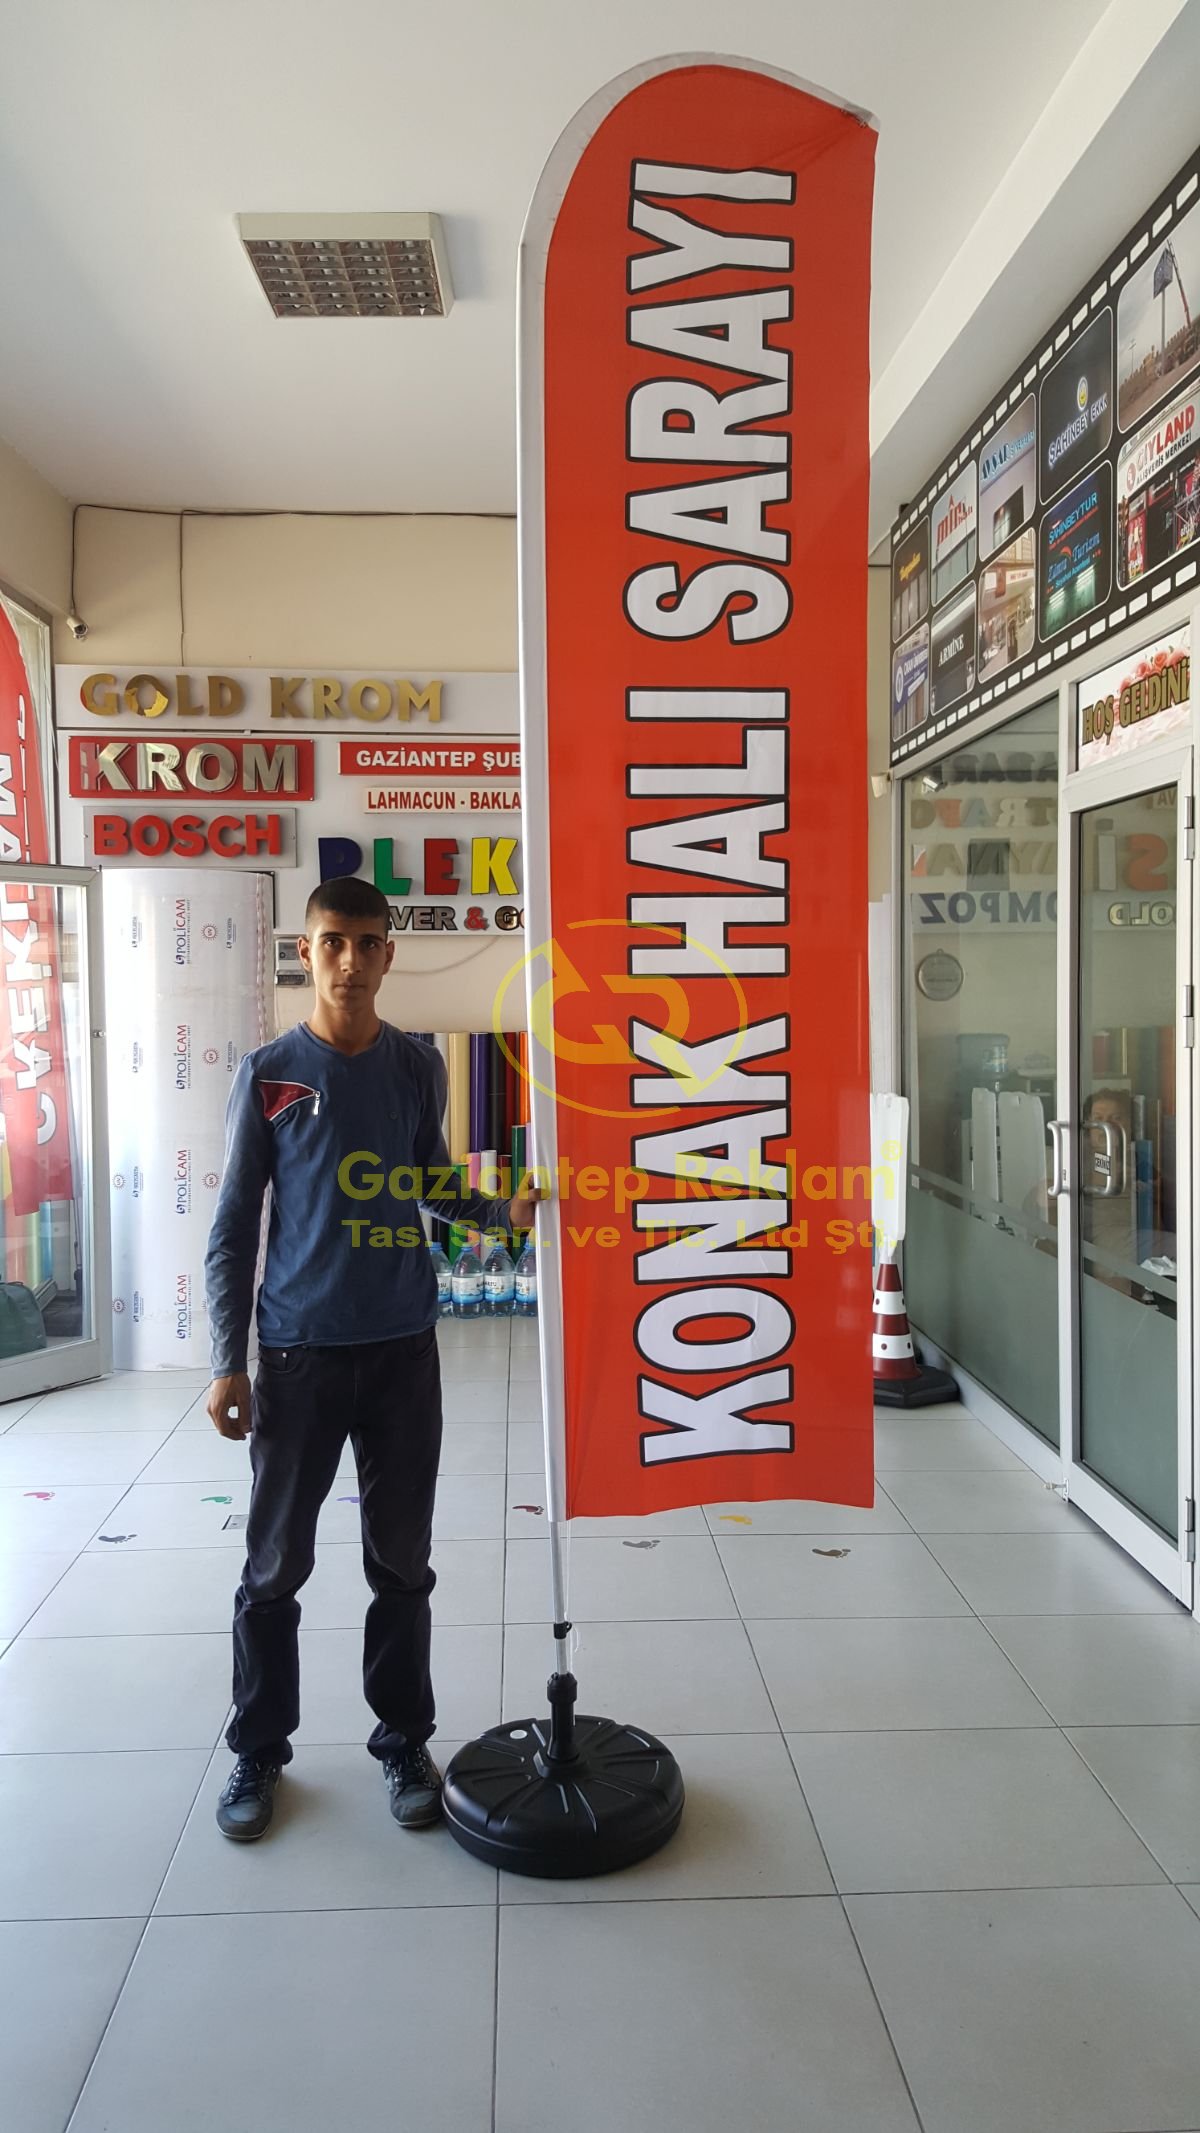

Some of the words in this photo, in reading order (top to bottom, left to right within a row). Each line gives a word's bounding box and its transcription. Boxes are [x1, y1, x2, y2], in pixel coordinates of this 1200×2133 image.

[622, 157, 797, 645] SARAYI
[80, 672, 246, 718] GOLD
[270, 677, 445, 722] KROM
[1081, 693, 1115, 746] HOŞ
[79, 742, 299, 793] KROM
[356, 747, 476, 768] GAZİANTEP
[368, 791, 456, 809] LAHMACUN
[94, 814, 282, 858] BOSCH
[626, 686, 792, 978] HALI
[629, 1011, 796, 1468] KONAK
